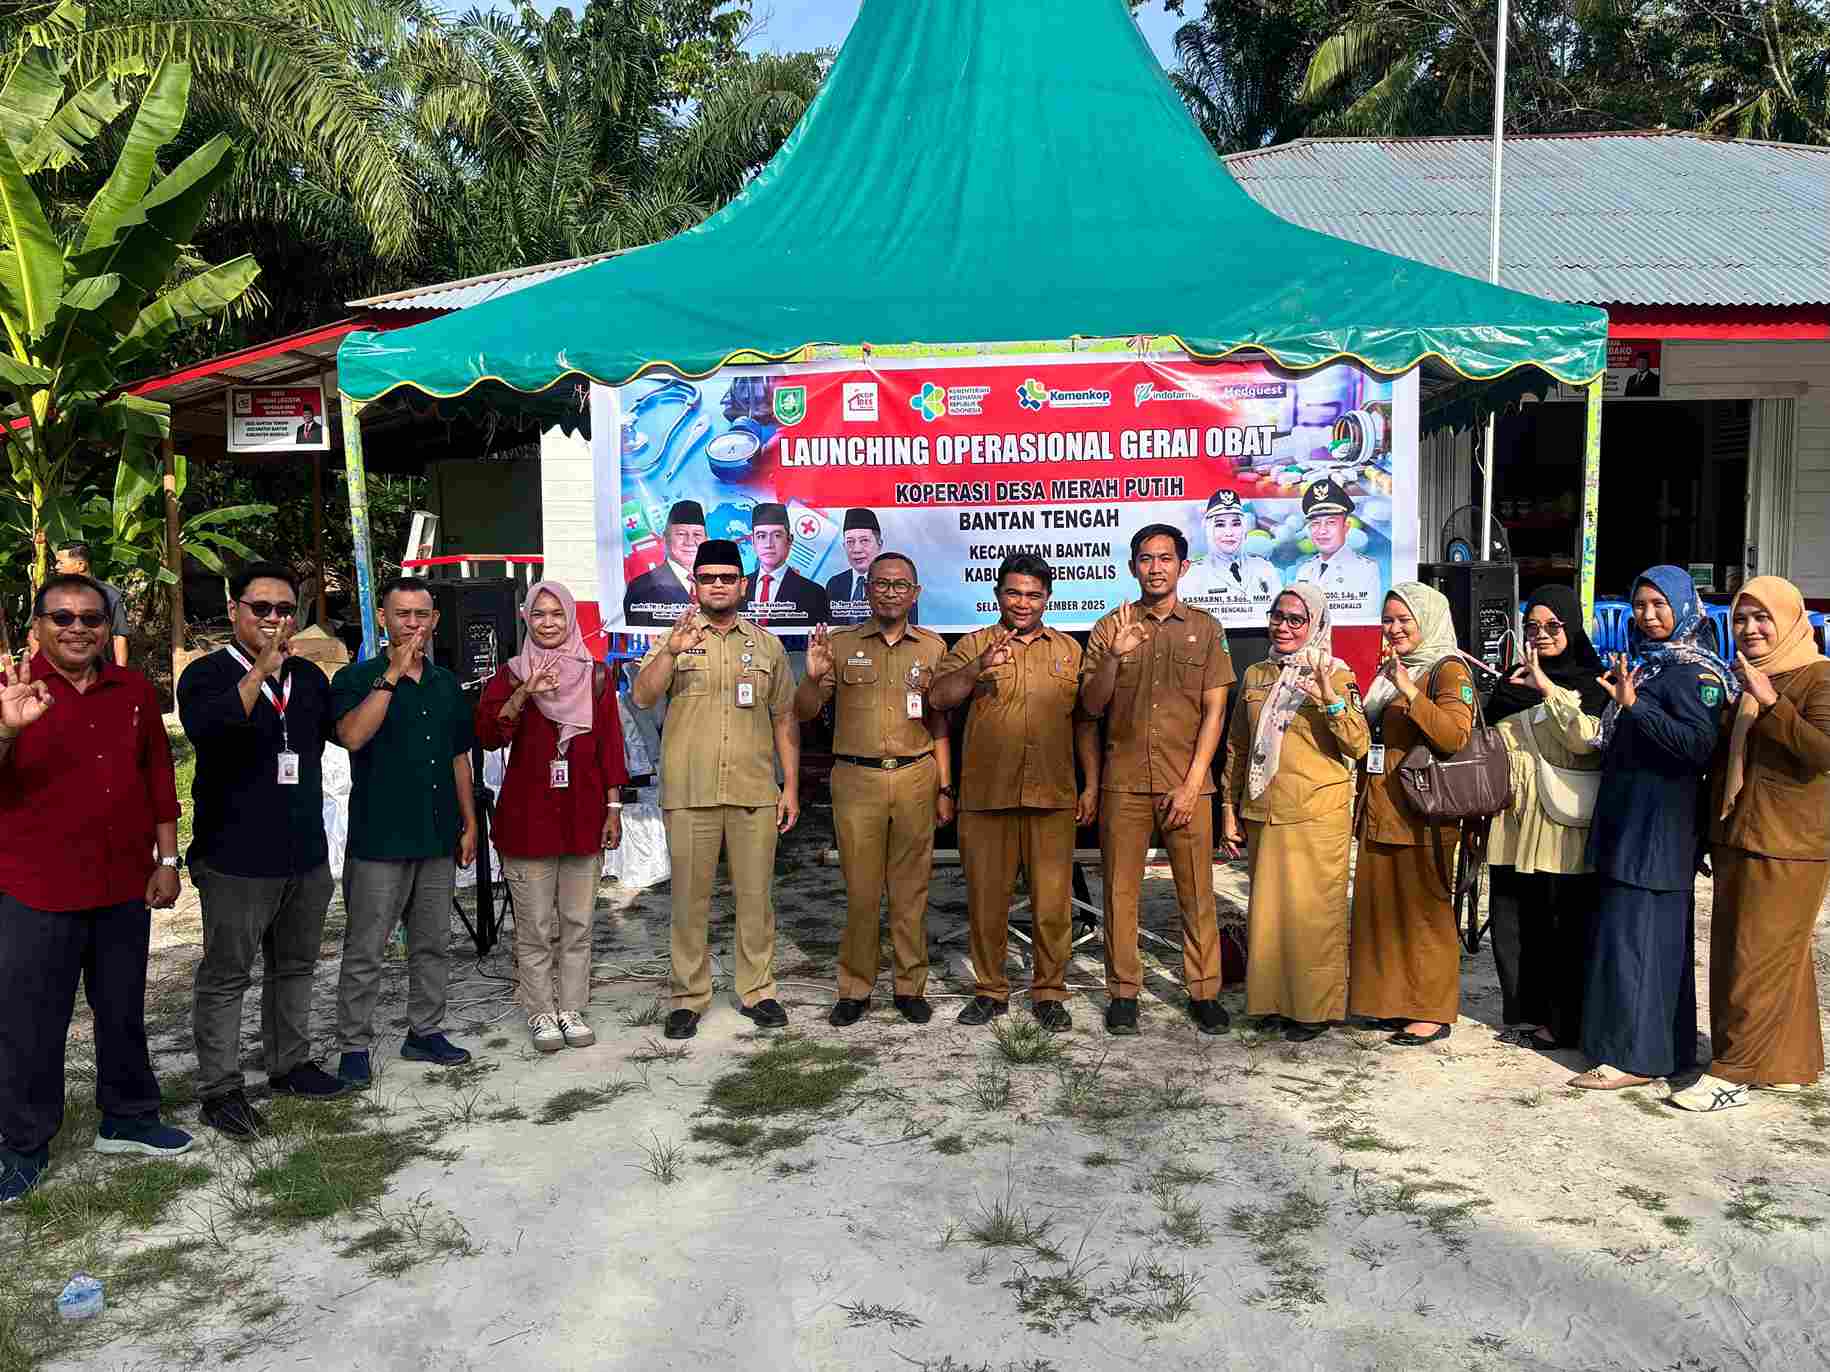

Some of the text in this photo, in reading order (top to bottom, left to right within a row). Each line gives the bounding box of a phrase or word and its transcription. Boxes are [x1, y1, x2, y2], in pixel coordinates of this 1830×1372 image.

[1050, 390, 1110, 402] Kemenkop
[780, 425, 1277, 467] LAUNCHING OPERASIONAL GERAI OBAT
[896, 477, 1184, 503] KOPERASI DESA MERAH PUTIH
[959, 508, 1120, 531] BANTAN TENGAH
[970, 542, 1111, 560] KECAMATAN BANTAN
[965, 567, 1001, 583] KABU
[1081, 599, 1105, 610] 2025
